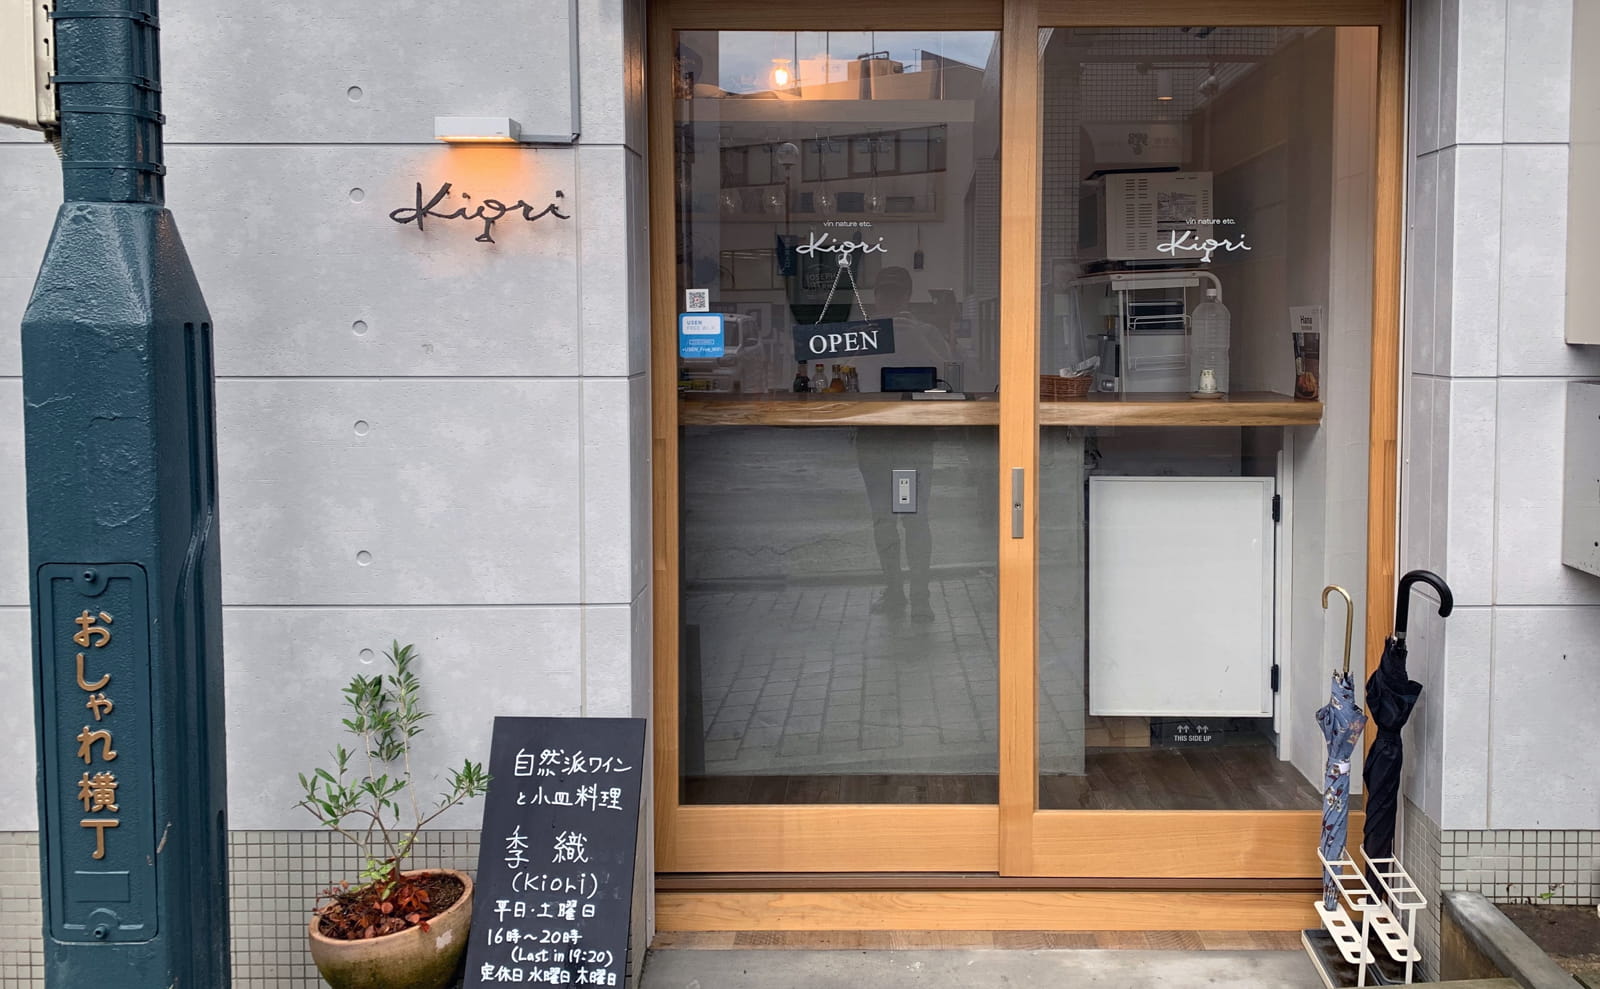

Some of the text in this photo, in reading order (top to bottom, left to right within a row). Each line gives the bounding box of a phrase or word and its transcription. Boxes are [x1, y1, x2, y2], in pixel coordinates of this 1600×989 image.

[389, 182, 570, 244] Kiori
[823, 219, 834, 227] vin
[1185, 217, 1196, 225] vin
[795, 231, 887, 264] Kiori
[1156, 230, 1251, 262] Kiori
[809, 330, 879, 354] OPEN
[72, 608, 120, 860] おしゃれ横丁
[514, 748, 632, 777] 自然派ワイン
[516, 783, 623, 811] と小皿料理
[511, 946, 613, 967] (Last in 19:20)
[481, 962, 617, 986] 定休日 水曜日 木曜日
